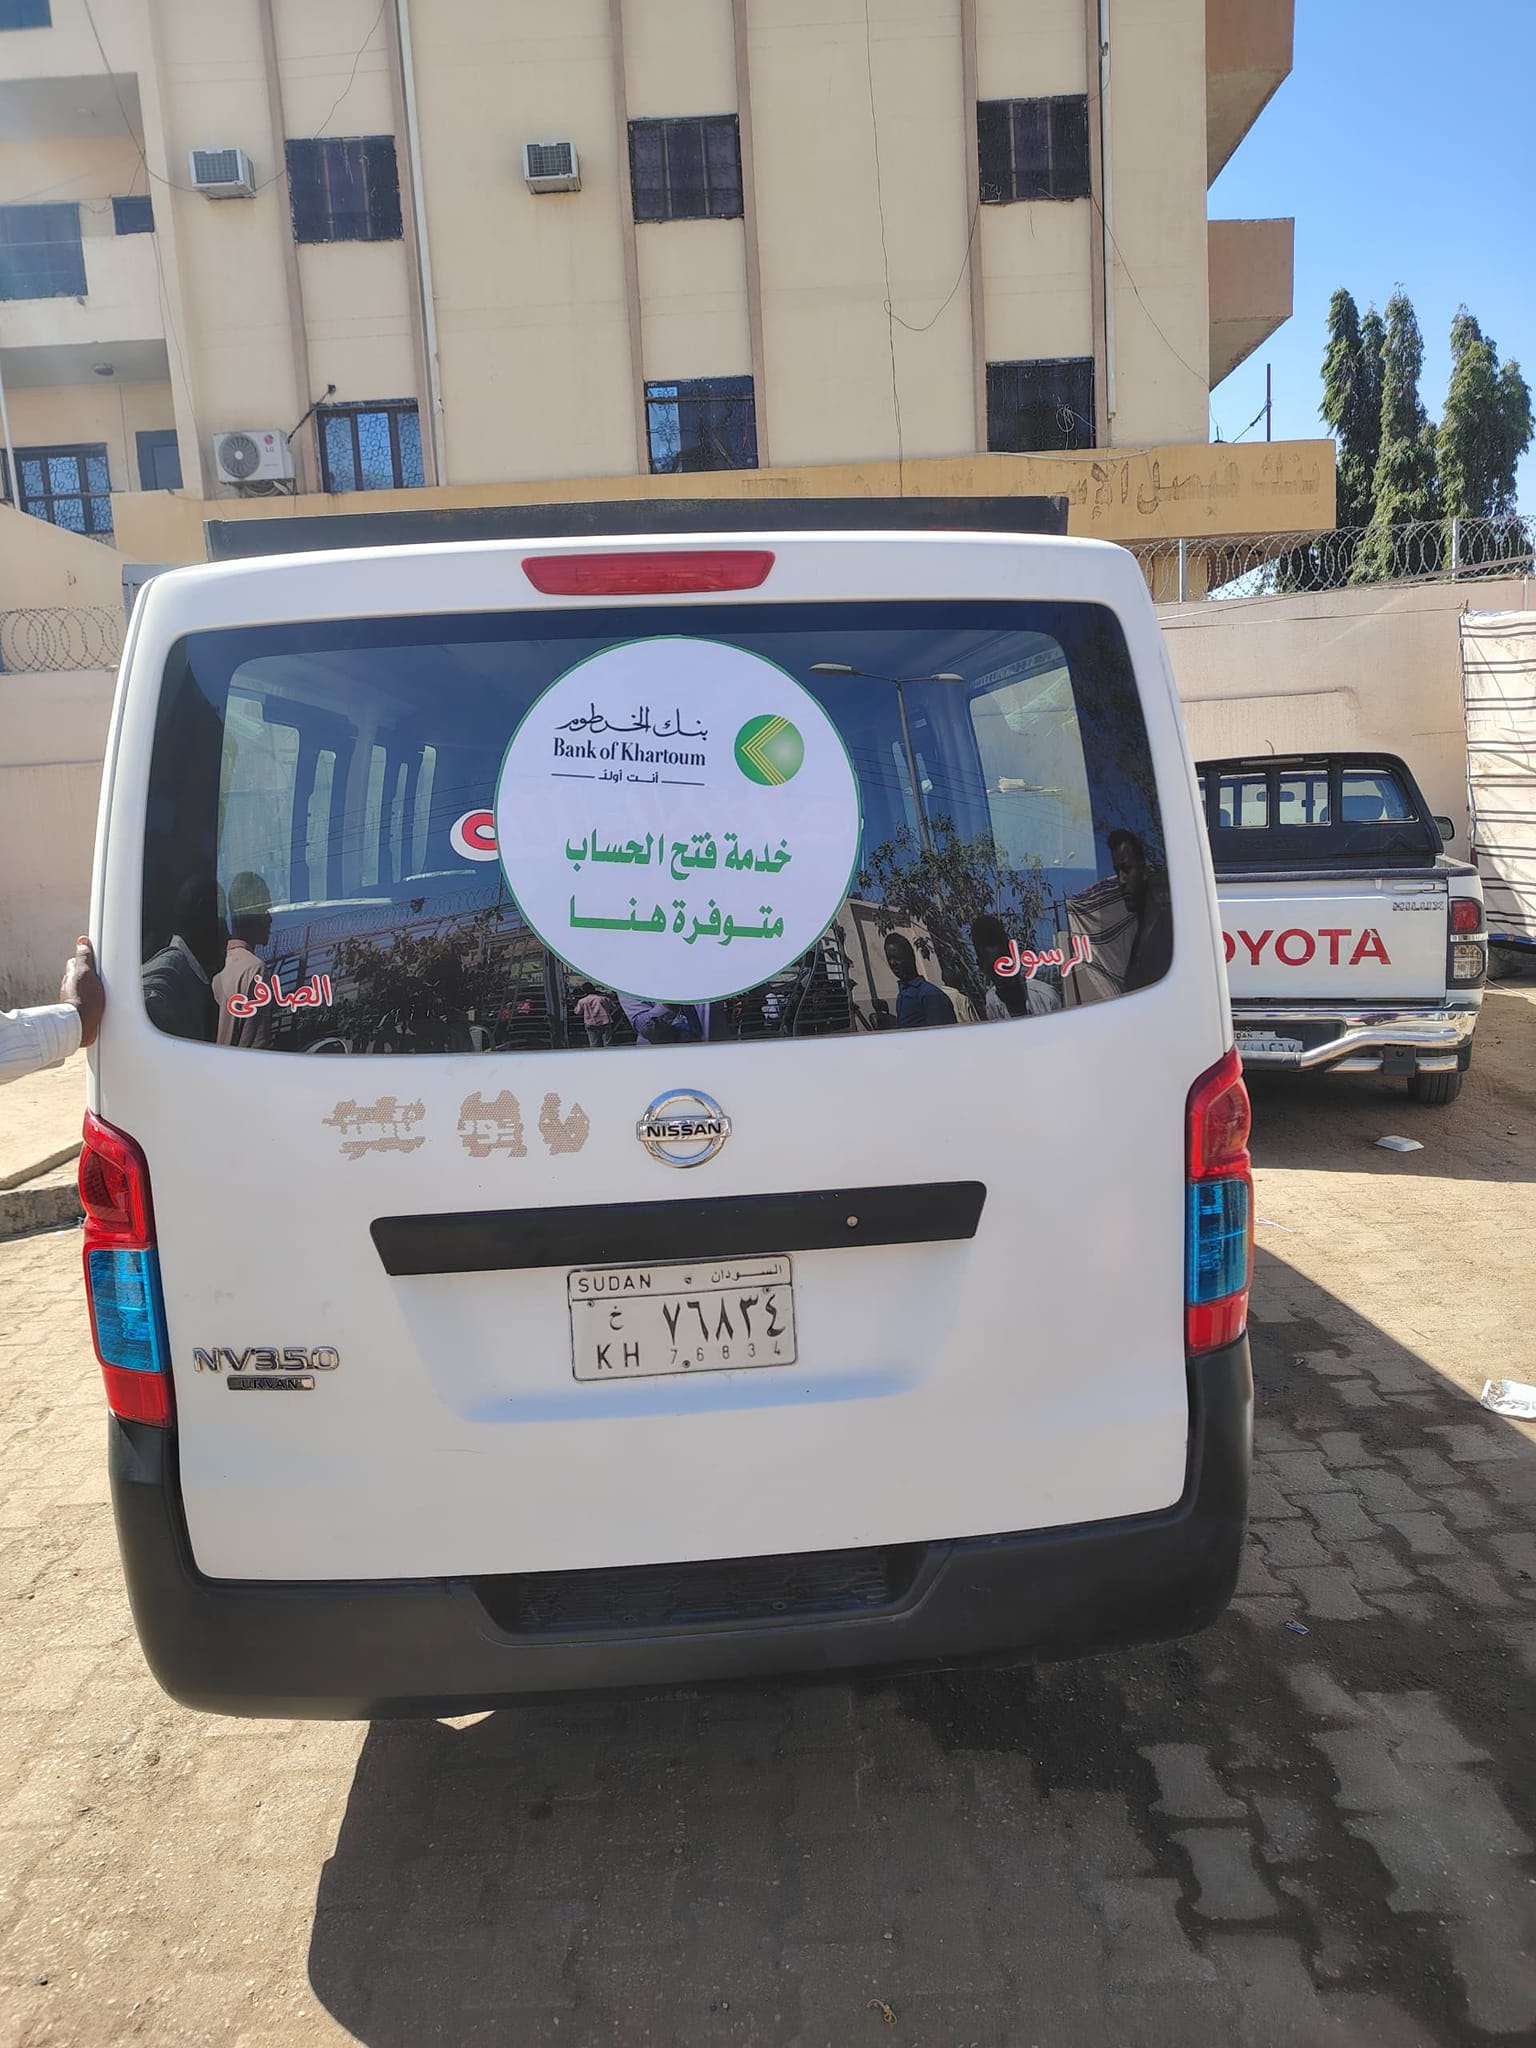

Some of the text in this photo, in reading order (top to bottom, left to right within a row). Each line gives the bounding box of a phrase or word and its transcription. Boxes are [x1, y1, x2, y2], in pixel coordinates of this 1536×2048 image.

[554, 702, 708, 741] بنك الخرطوم
[553, 737, 706, 766] Bank of Khartoum
[626, 771, 659, 784] أنت
[565, 828, 793, 881] خدمة فتح الحساب
[1392, 901, 1444, 911] HILUX
[570, 894, 784, 946] متوفرة هنا
[993, 935, 1093, 979] الرسول
[1223, 928, 1392, 966] YOTA
[647, 1122, 721, 1137] NISSAN
[578, 1274, 652, 1293] SUDAN
[710, 1264, 783, 1284] السودان
[609, 1305, 625, 1331] خ
[192, 1346, 340, 1373] NV350
[240, 1377, 299, 1390] URVAN
